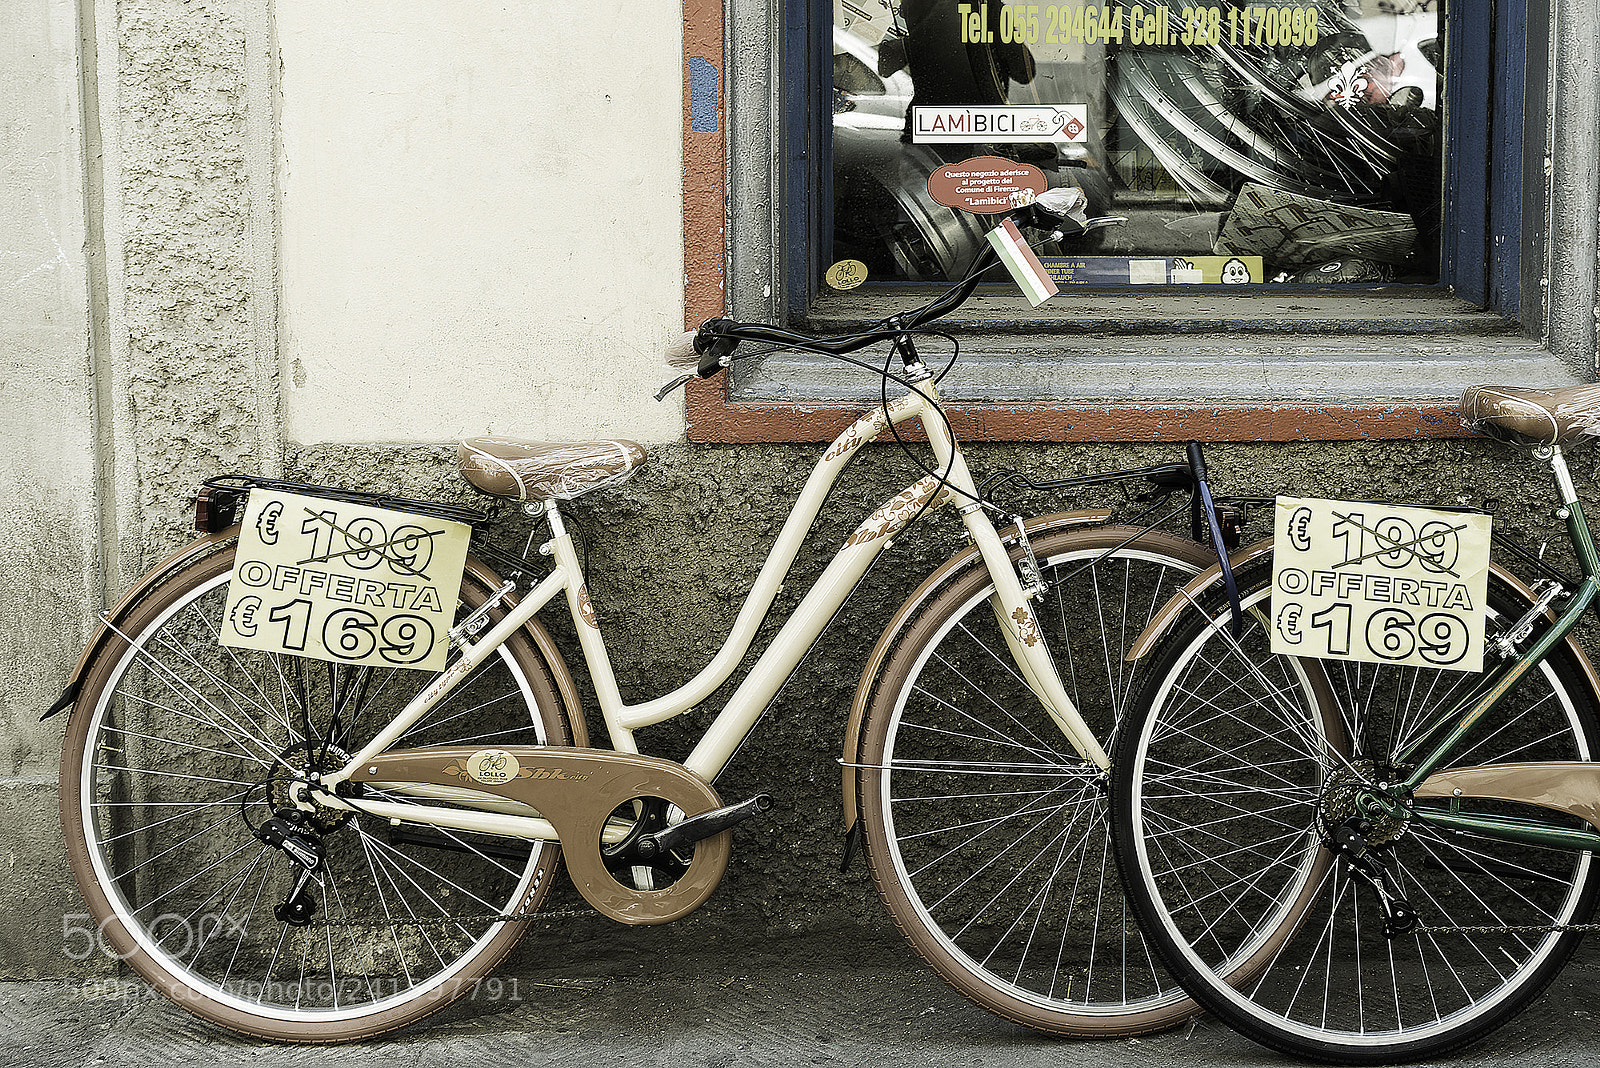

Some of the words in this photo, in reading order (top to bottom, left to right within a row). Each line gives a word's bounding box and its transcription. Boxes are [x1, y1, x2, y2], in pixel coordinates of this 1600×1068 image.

[957, 4, 994, 44] Tel.
[1000, 4, 1040, 45] 055
[1045, 5, 1124, 46] 294644
[1130, 5, 1177, 46] Cell.
[1181, 5, 1221, 46] 328
[1228, 6, 1318, 47] 1170898
[944, 171, 970, 179] Questo
[971, 169, 999, 179] negozio
[999, 169, 1030, 177] aderisce
[961, 178, 969, 186] al
[969, 178, 1000, 186] progetto
[300, 510, 434, 577] 199
[1332, 512, 1459, 574] 199
[238, 560, 443, 613] OFFERTA
[1277, 567, 1474, 611] OFFERTA
[479, 771, 507, 779] LOLLO
[518, 868, 545, 915] KENDA
